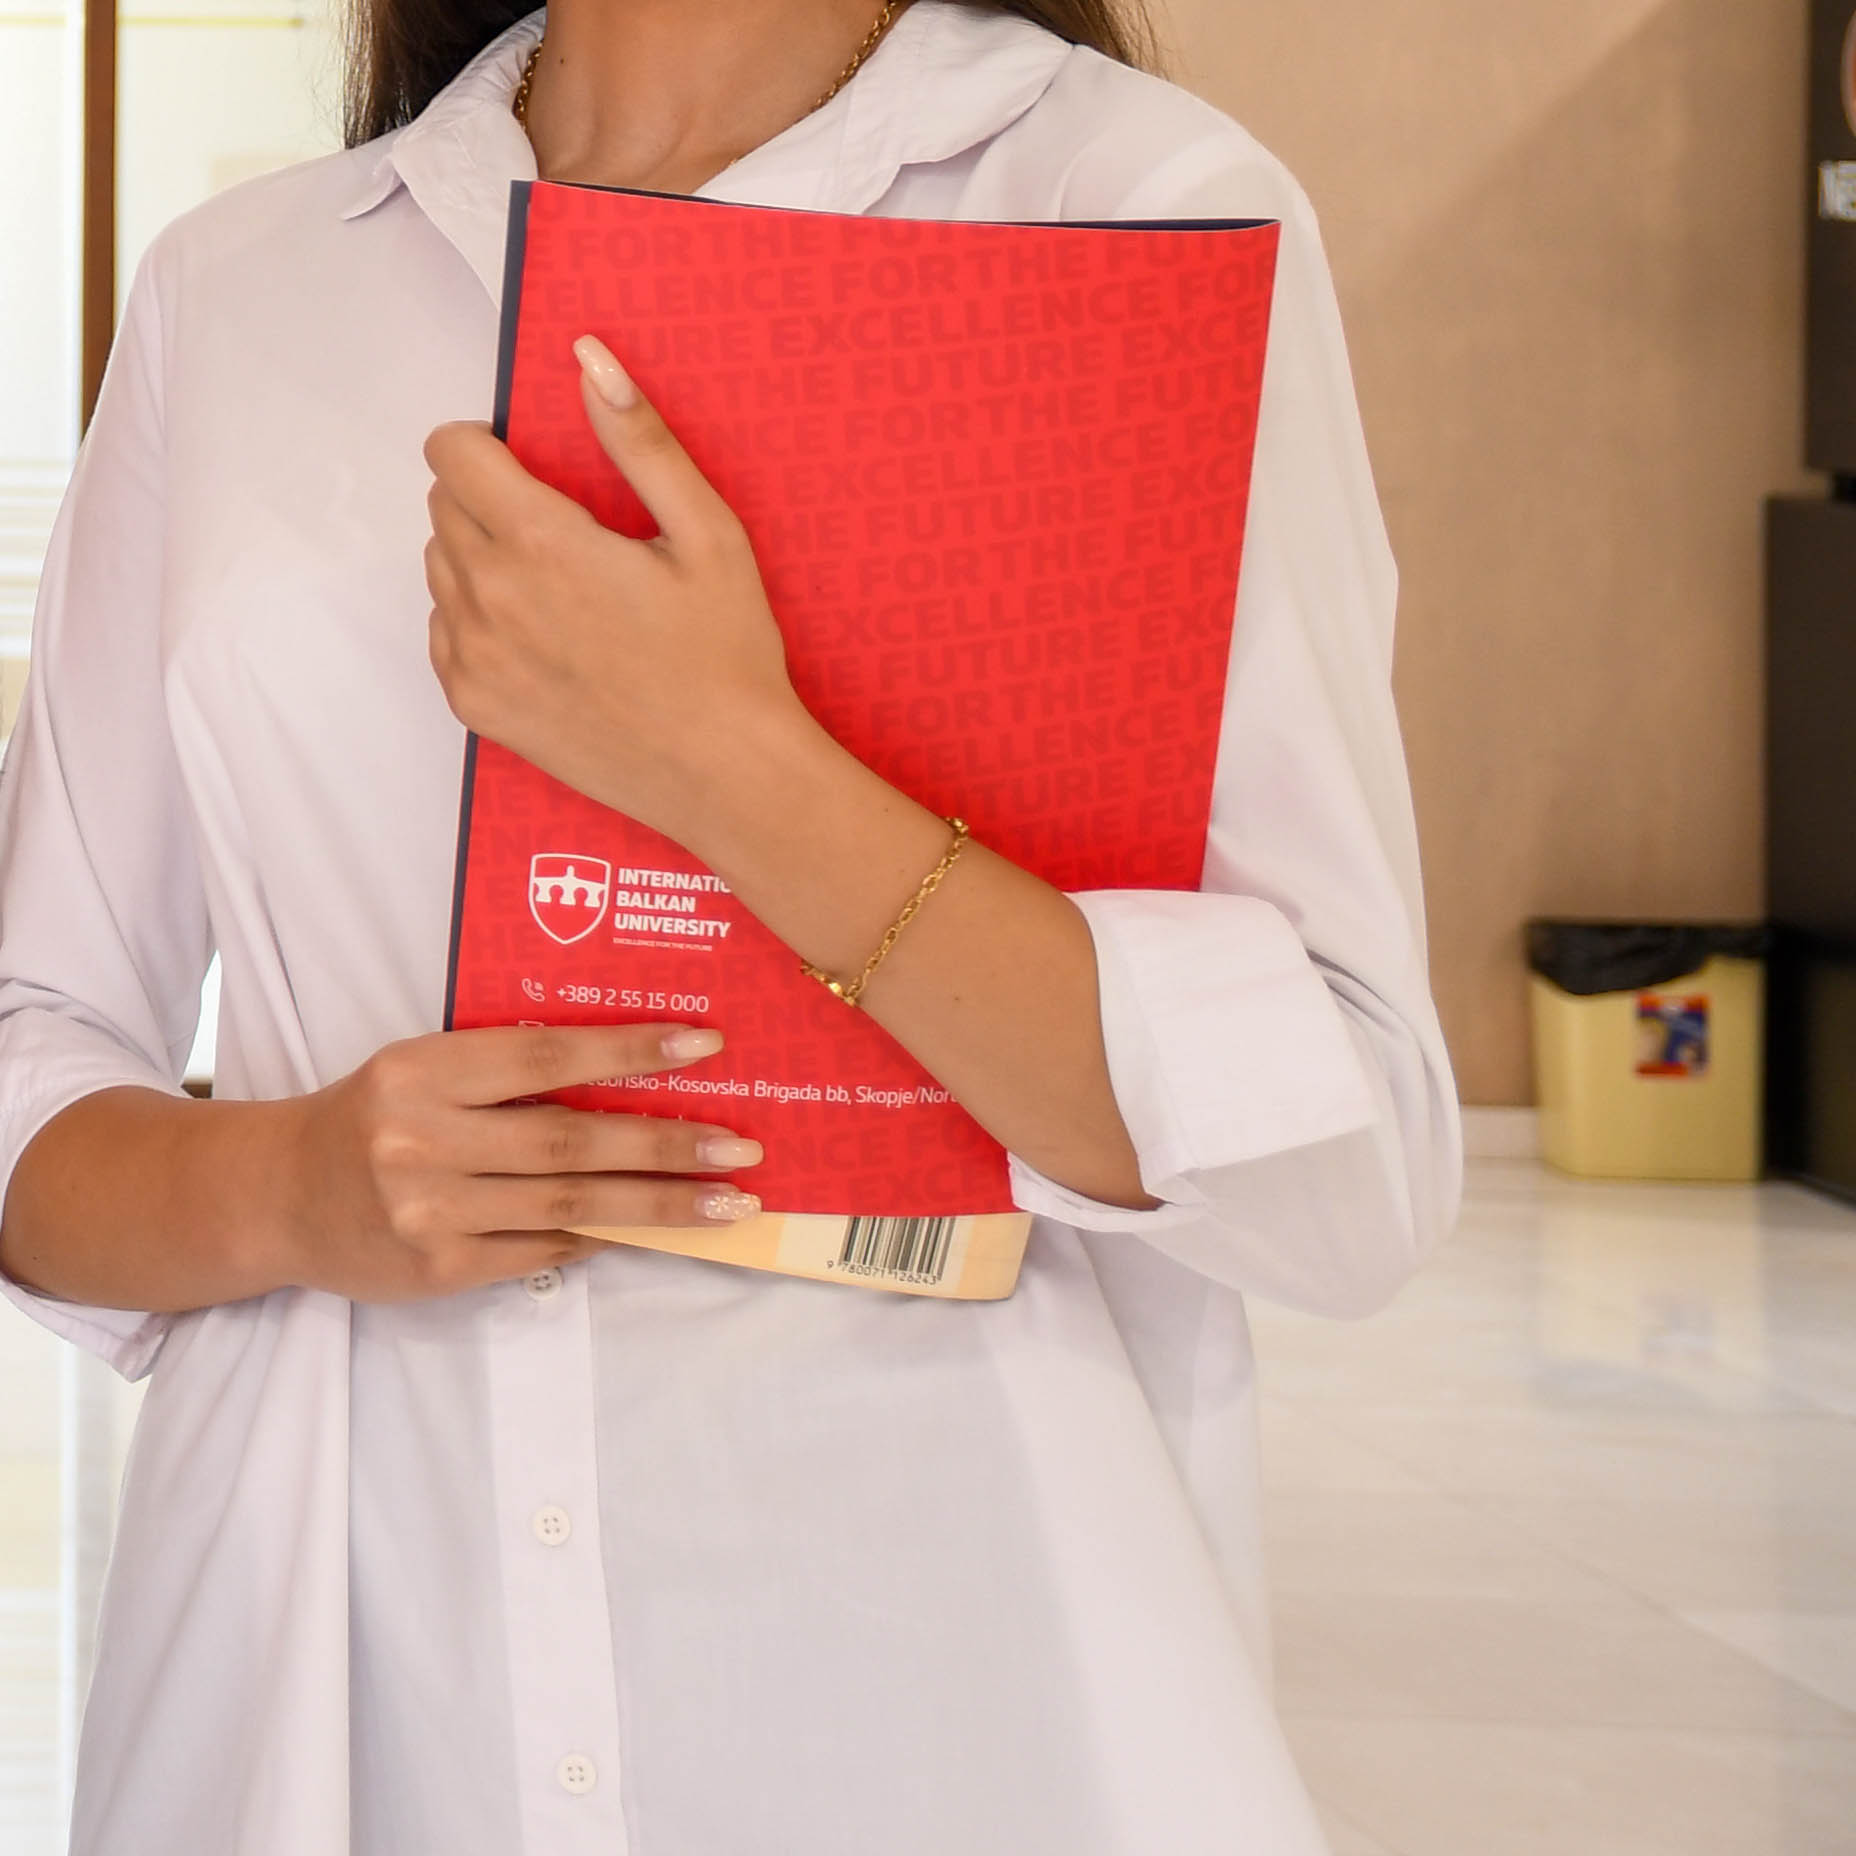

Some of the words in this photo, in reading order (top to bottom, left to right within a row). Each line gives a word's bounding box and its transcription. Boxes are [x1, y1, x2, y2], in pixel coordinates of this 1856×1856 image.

[771, 277, 1160, 360] EXCELLENCE
[852, 331, 1105, 401] FUTURE
[784, 421, 1169, 506] EXCELLENCE
[866, 479, 1114, 547] FUTURE
[879, 620, 1120, 692] FUTURE
[616, 890, 696, 913] BALKAN
[614, 913, 731, 938] UNIVERSITY
[556, 986, 600, 1005] +389
[604, 988, 616, 1006] 2
[620, 989, 642, 1008] 55
[646, 991, 666, 1010] 15
[670, 993, 709, 1012] 000
[754, 1080, 821, 1104] Brigada
[825, 1085, 851, 1104] bb,
[826, 1260, 834, 1269] 9
